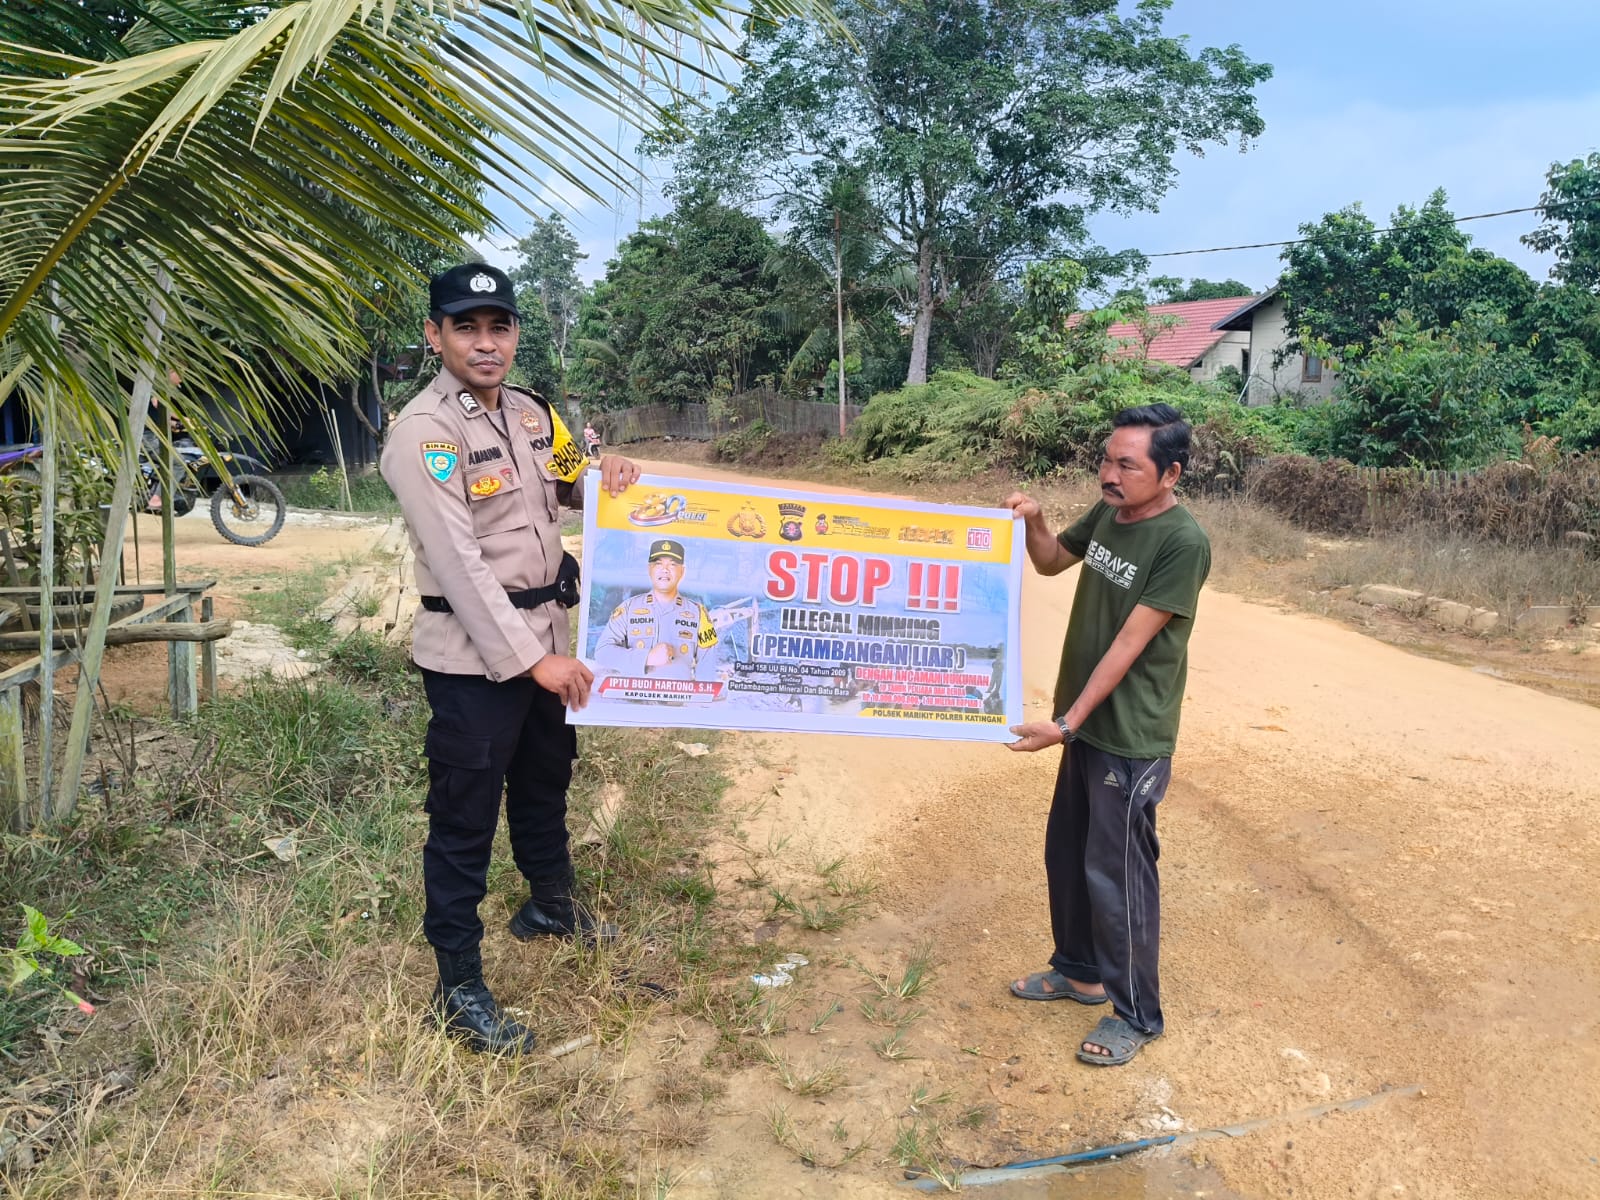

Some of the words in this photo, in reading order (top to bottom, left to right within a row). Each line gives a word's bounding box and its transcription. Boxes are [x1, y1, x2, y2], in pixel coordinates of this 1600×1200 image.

[967, 531, 990, 547] 110
[765, 550, 892, 606] STOP
[907, 562, 960, 611] !!!
[675, 619, 698, 629] POLRI
[781, 608, 853, 634] ILLEGAL
[857, 614, 940, 641] MINNING
[736, 662, 754, 672] Pasal
[768, 665, 779, 673] UU
[780, 665, 787, 673] RI
[788, 665, 800, 674] No.
[800, 666, 809, 674] 04
[810, 667, 830, 676] Tahun
[856, 667, 893, 681] DENGAN
[895, 670, 942, 684] ANCAMAN
[609, 678, 630, 688] IPTU
[632, 678, 652, 689] BUDI
[655, 679, 696, 692] HARTONO,
[698, 682, 715, 692] S.H.
[729, 681, 778, 694] Pertambangan
[779, 684, 802, 694] Mineral
[803, 686, 817, 694] Dan
[818, 686, 833, 695] Batu
[834, 687, 850, 696] Bara
[872, 709, 902, 717] POLSEK
[903, 711, 933, 720] MARIKIT
[935, 712, 963, 721] POLRES
[964, 713, 1002, 724] KATINGAN
